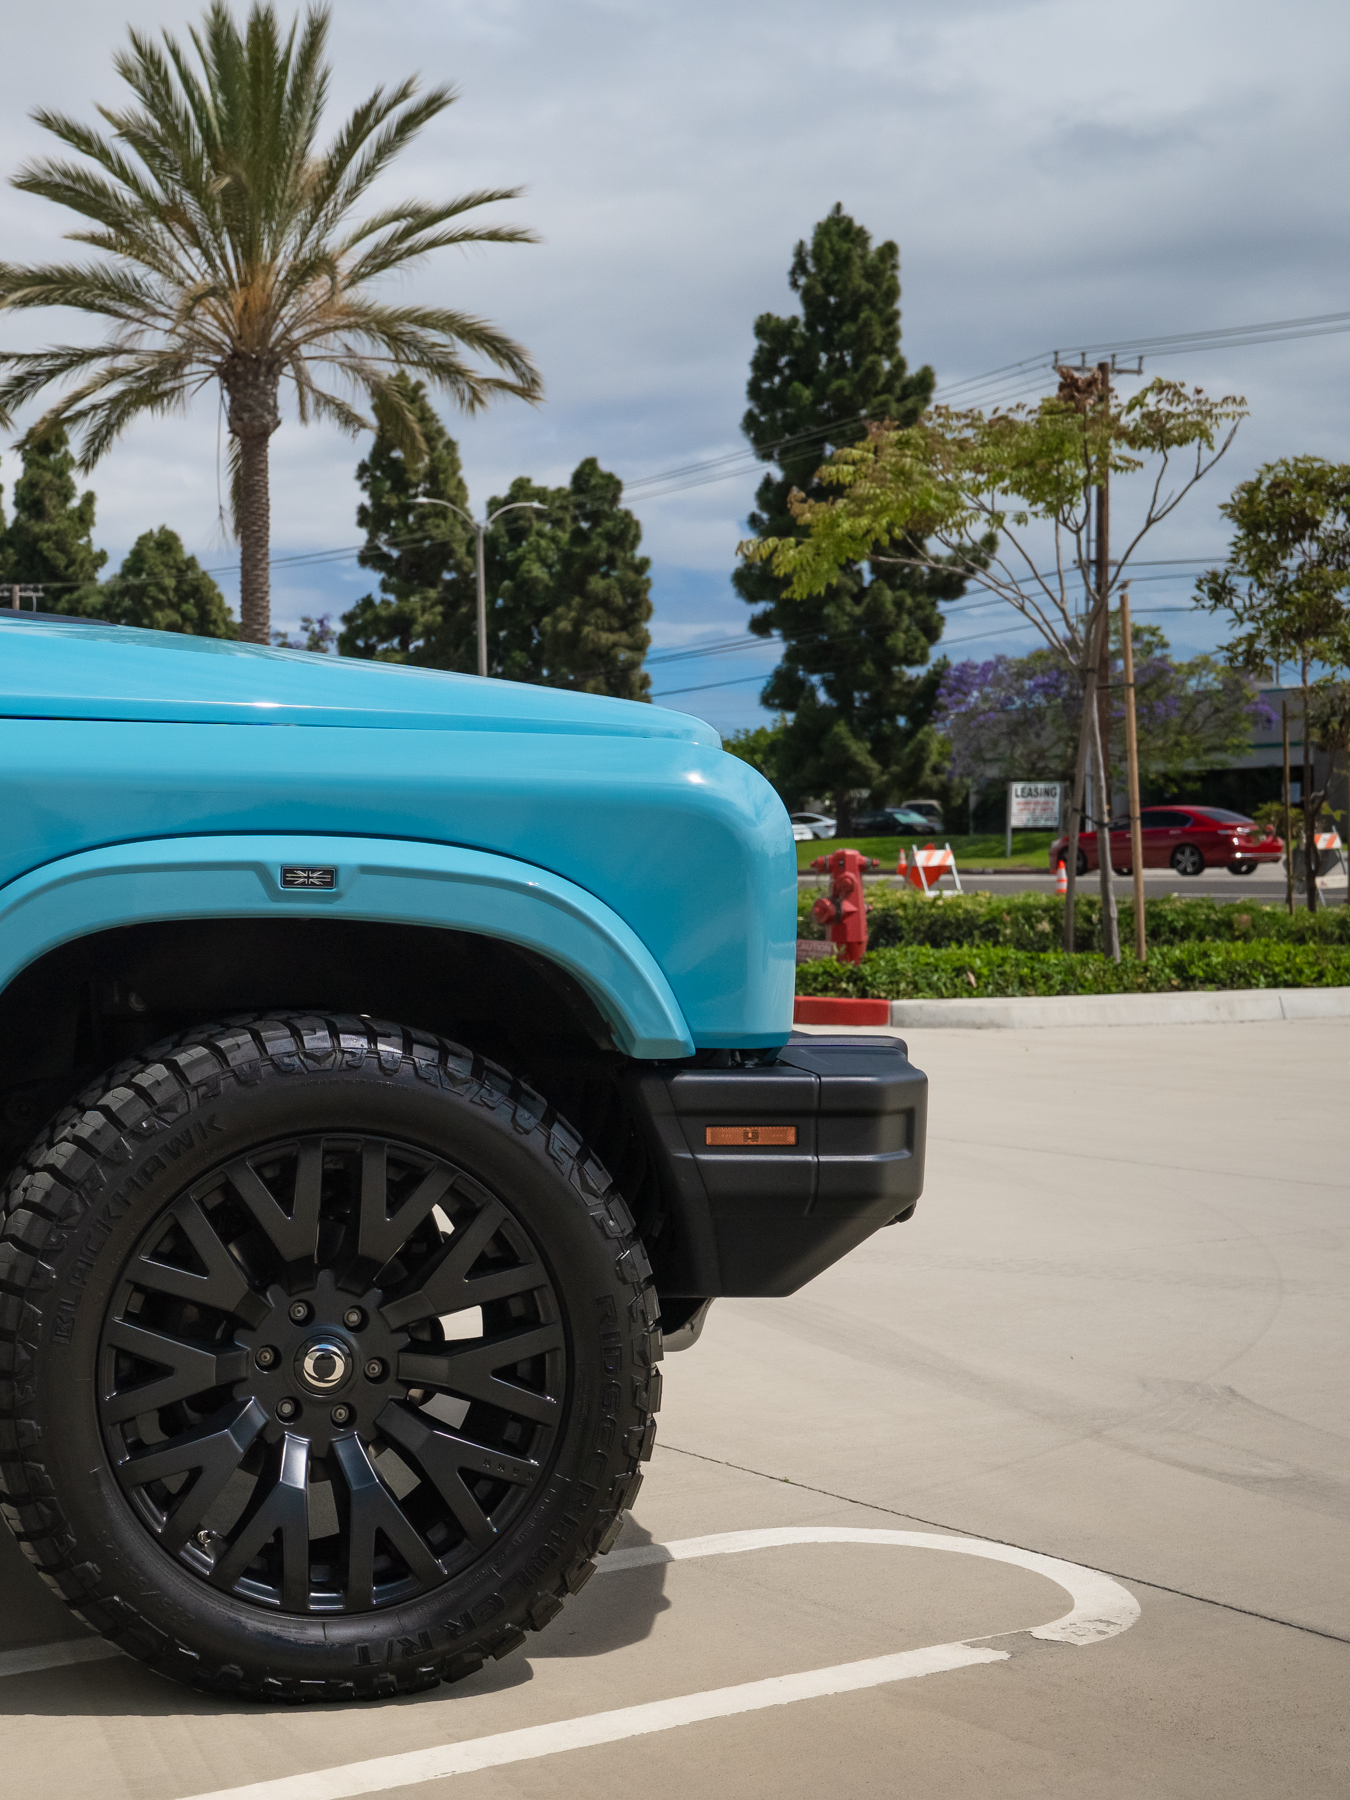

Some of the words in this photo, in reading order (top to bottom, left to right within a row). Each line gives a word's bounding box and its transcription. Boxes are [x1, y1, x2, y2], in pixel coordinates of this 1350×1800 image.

[1014, 786, 1057, 798] LEASING
[51, 1108, 226, 1344] BLACKHAWK
[439, 1291, 623, 1640] RIDGECRAWLER
[351, 1625, 435, 1669] R/T
